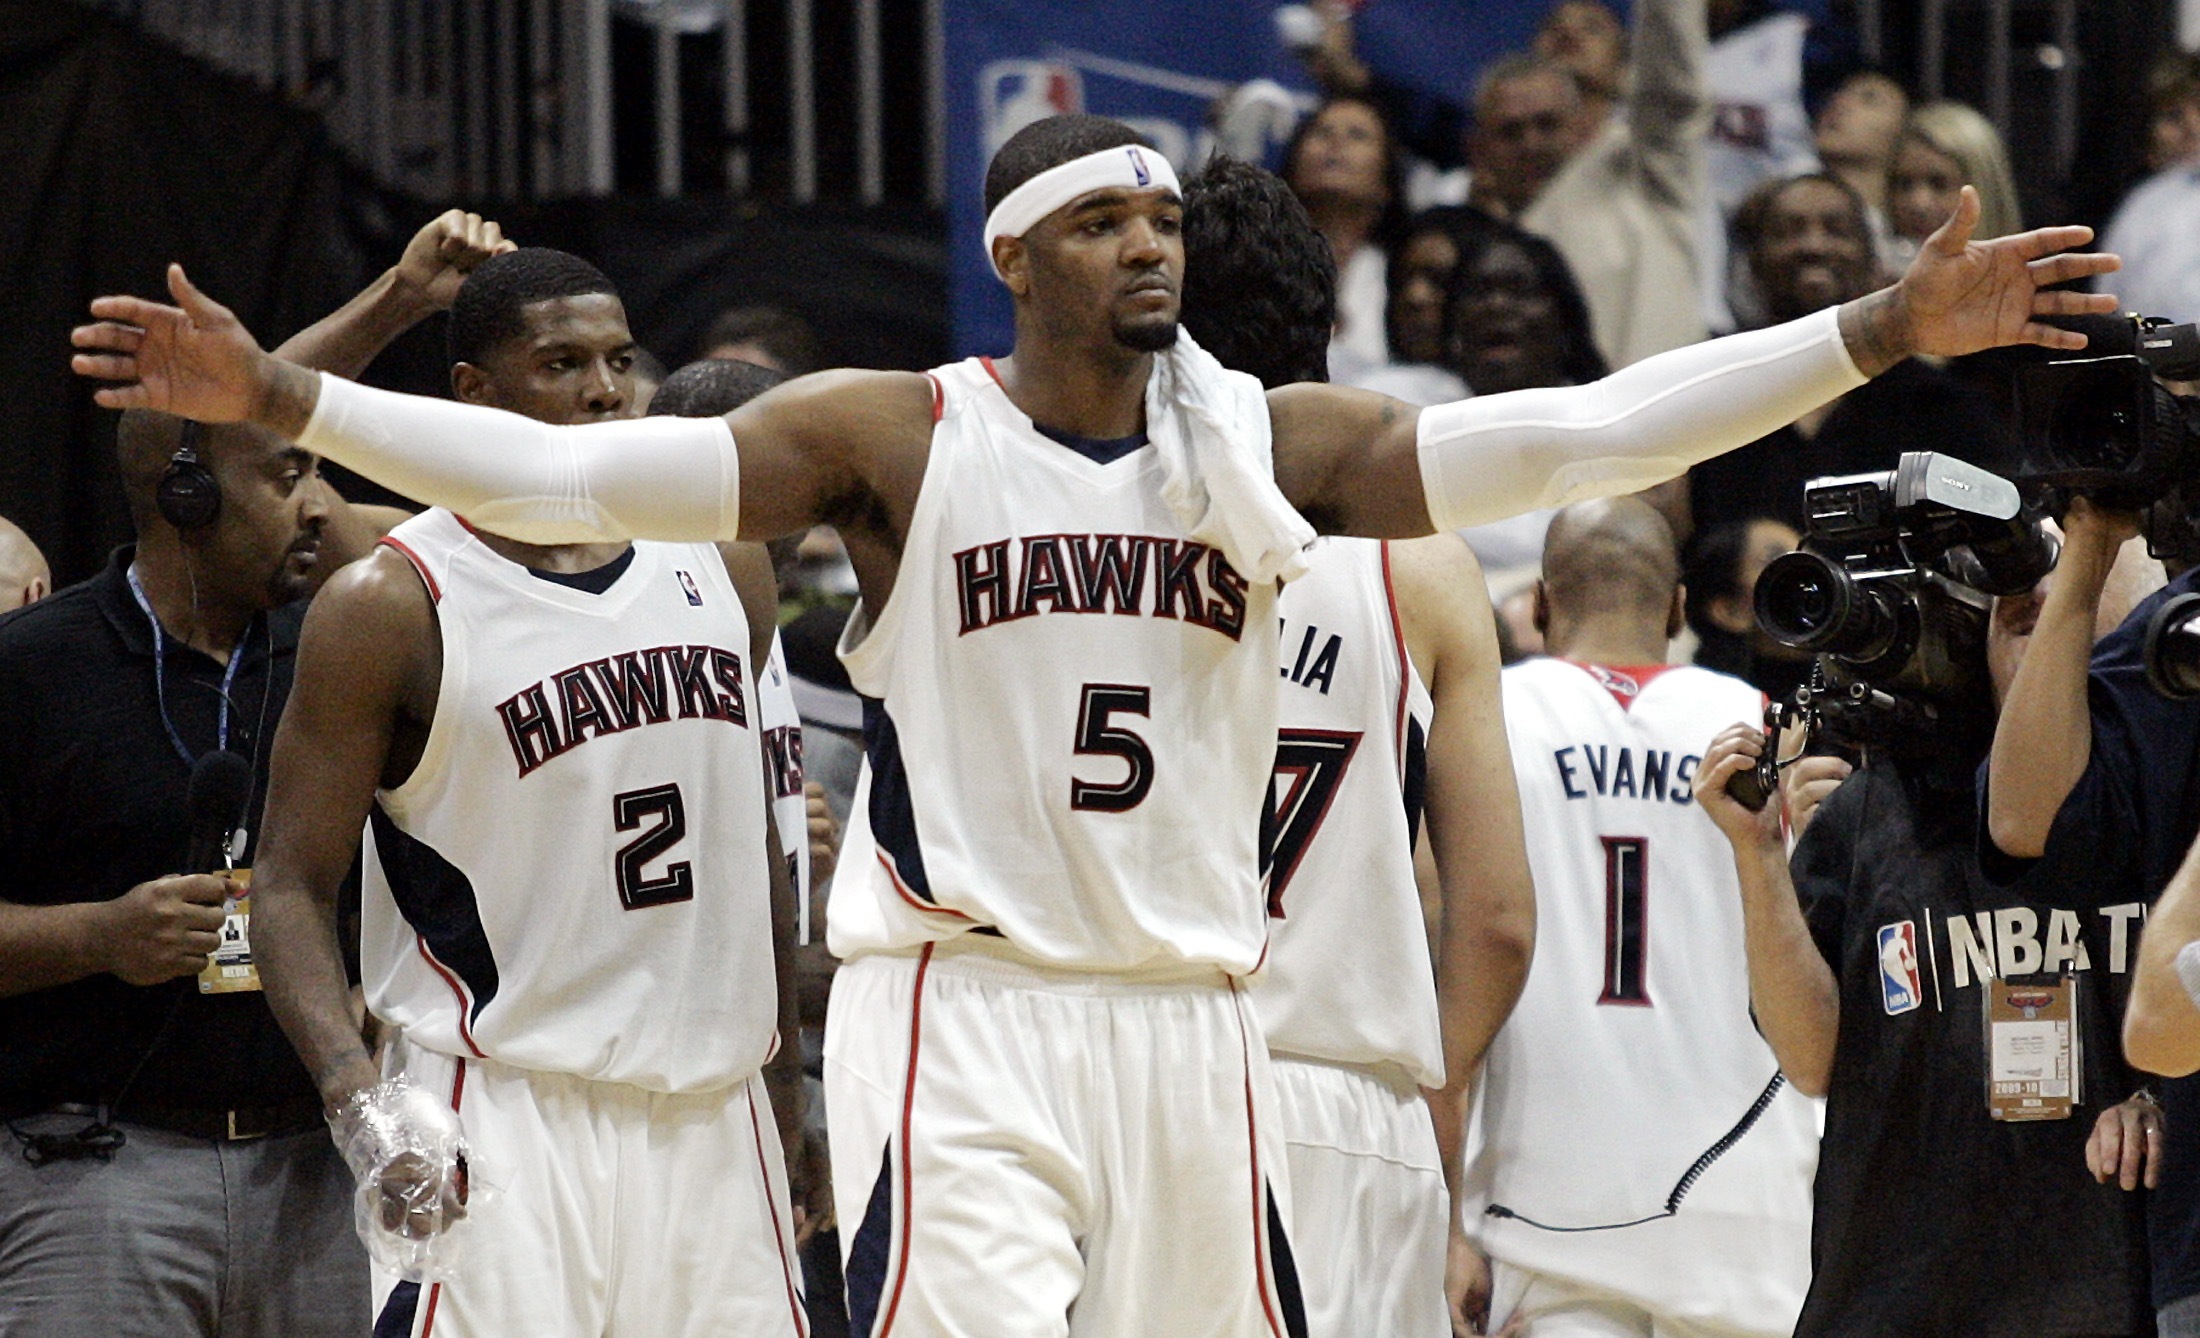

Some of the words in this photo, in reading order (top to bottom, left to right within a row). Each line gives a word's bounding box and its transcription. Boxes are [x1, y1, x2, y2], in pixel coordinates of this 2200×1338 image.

[953, 532, 1248, 643] HAWKS
[495, 644, 749, 779] HAWKS
[1070, 682, 1155, 814] 5
[1554, 743, 1704, 806] EVANS
[613, 781, 694, 911] 2
[1266, 727, 1365, 920] 7
[1596, 835, 1654, 1008] 1
[1947, 906, 2091, 989] NBA
[2098, 902, 2148, 974] T
